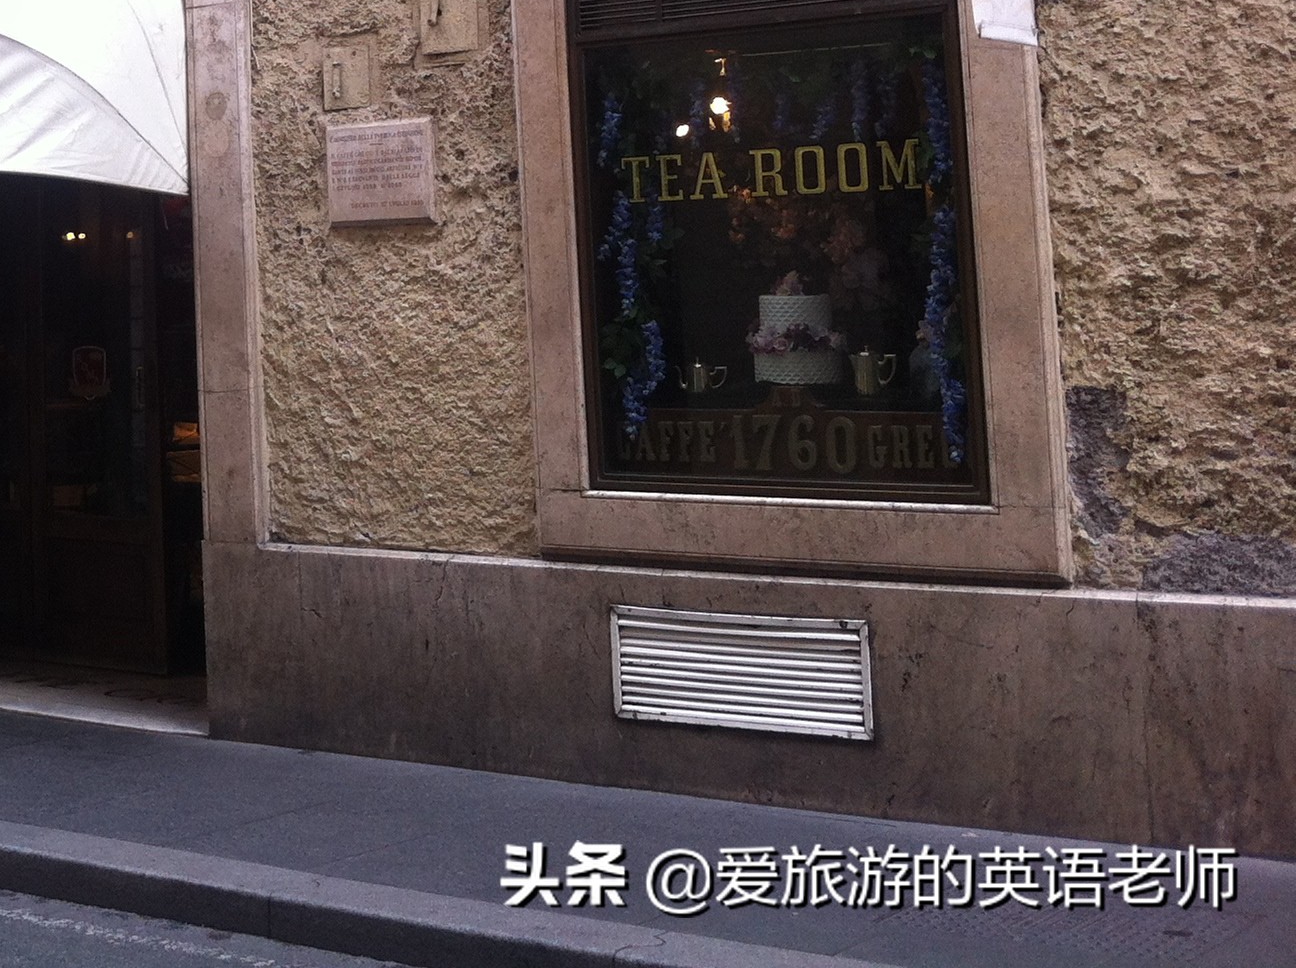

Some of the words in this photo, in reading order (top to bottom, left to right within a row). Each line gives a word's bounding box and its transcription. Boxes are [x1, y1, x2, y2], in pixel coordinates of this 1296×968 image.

[621, 148, 729, 205] TEA
[749, 137, 923, 199] ROOM
[731, 414, 856, 474] 1760
